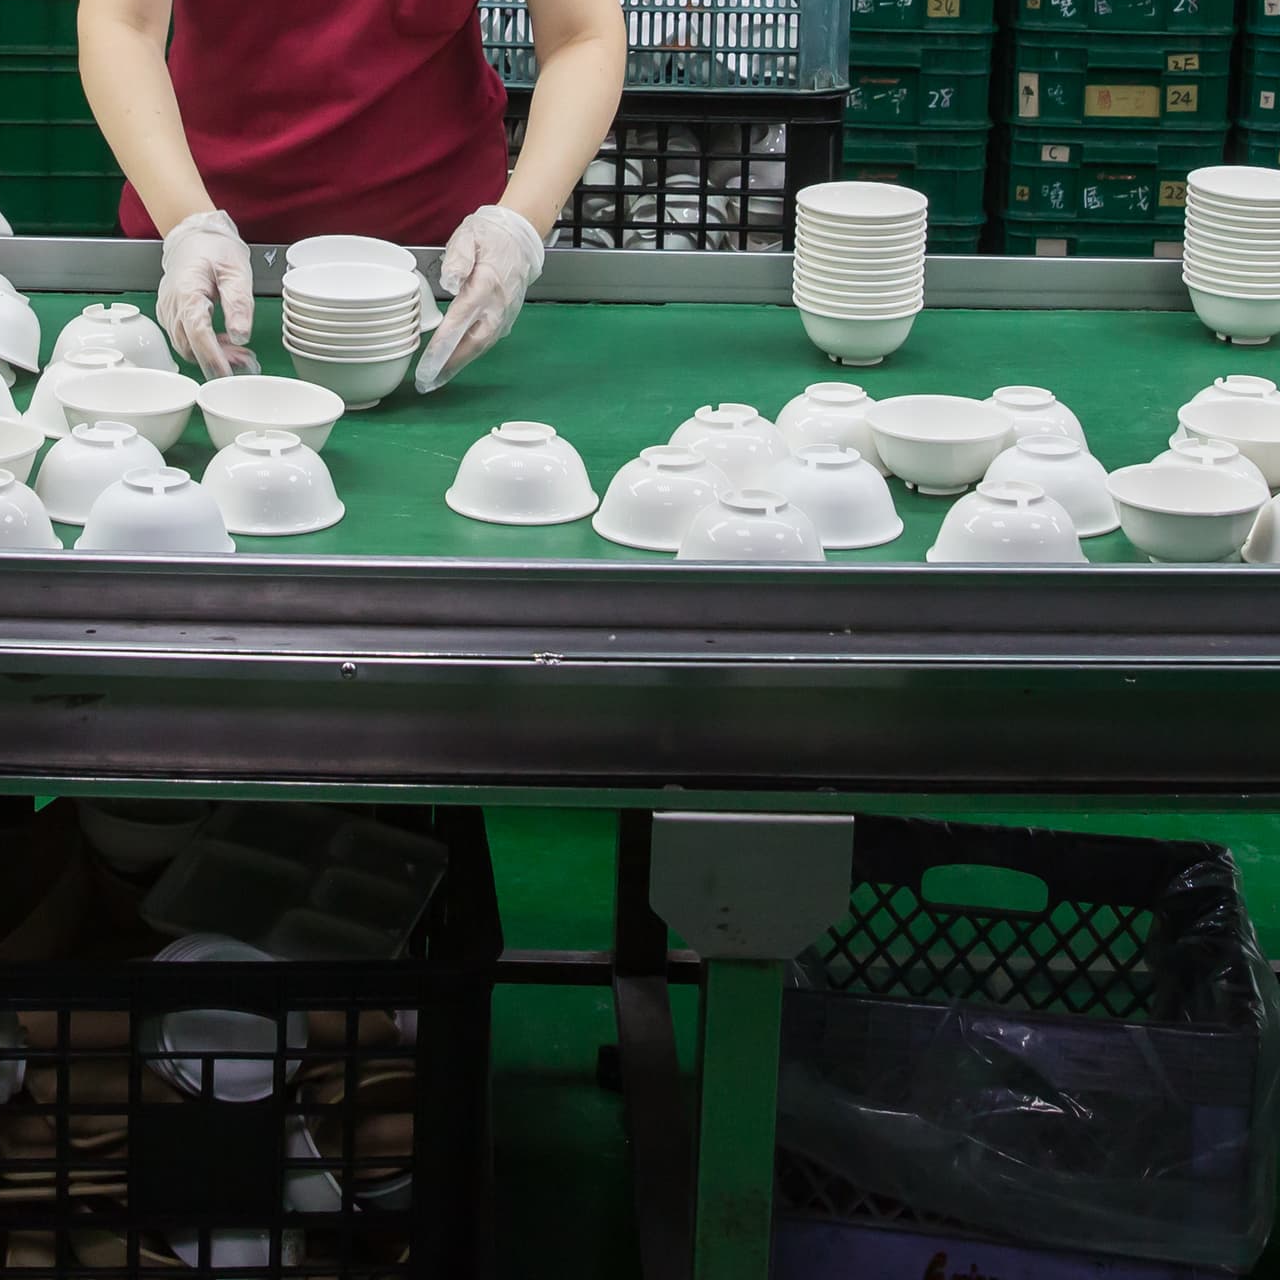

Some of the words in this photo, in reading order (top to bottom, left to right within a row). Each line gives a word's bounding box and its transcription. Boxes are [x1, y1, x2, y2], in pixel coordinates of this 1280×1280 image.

[932, 0, 956, 16] 24
[927, 87, 955, 110] 28
[1169, 90, 1194, 107] 24
